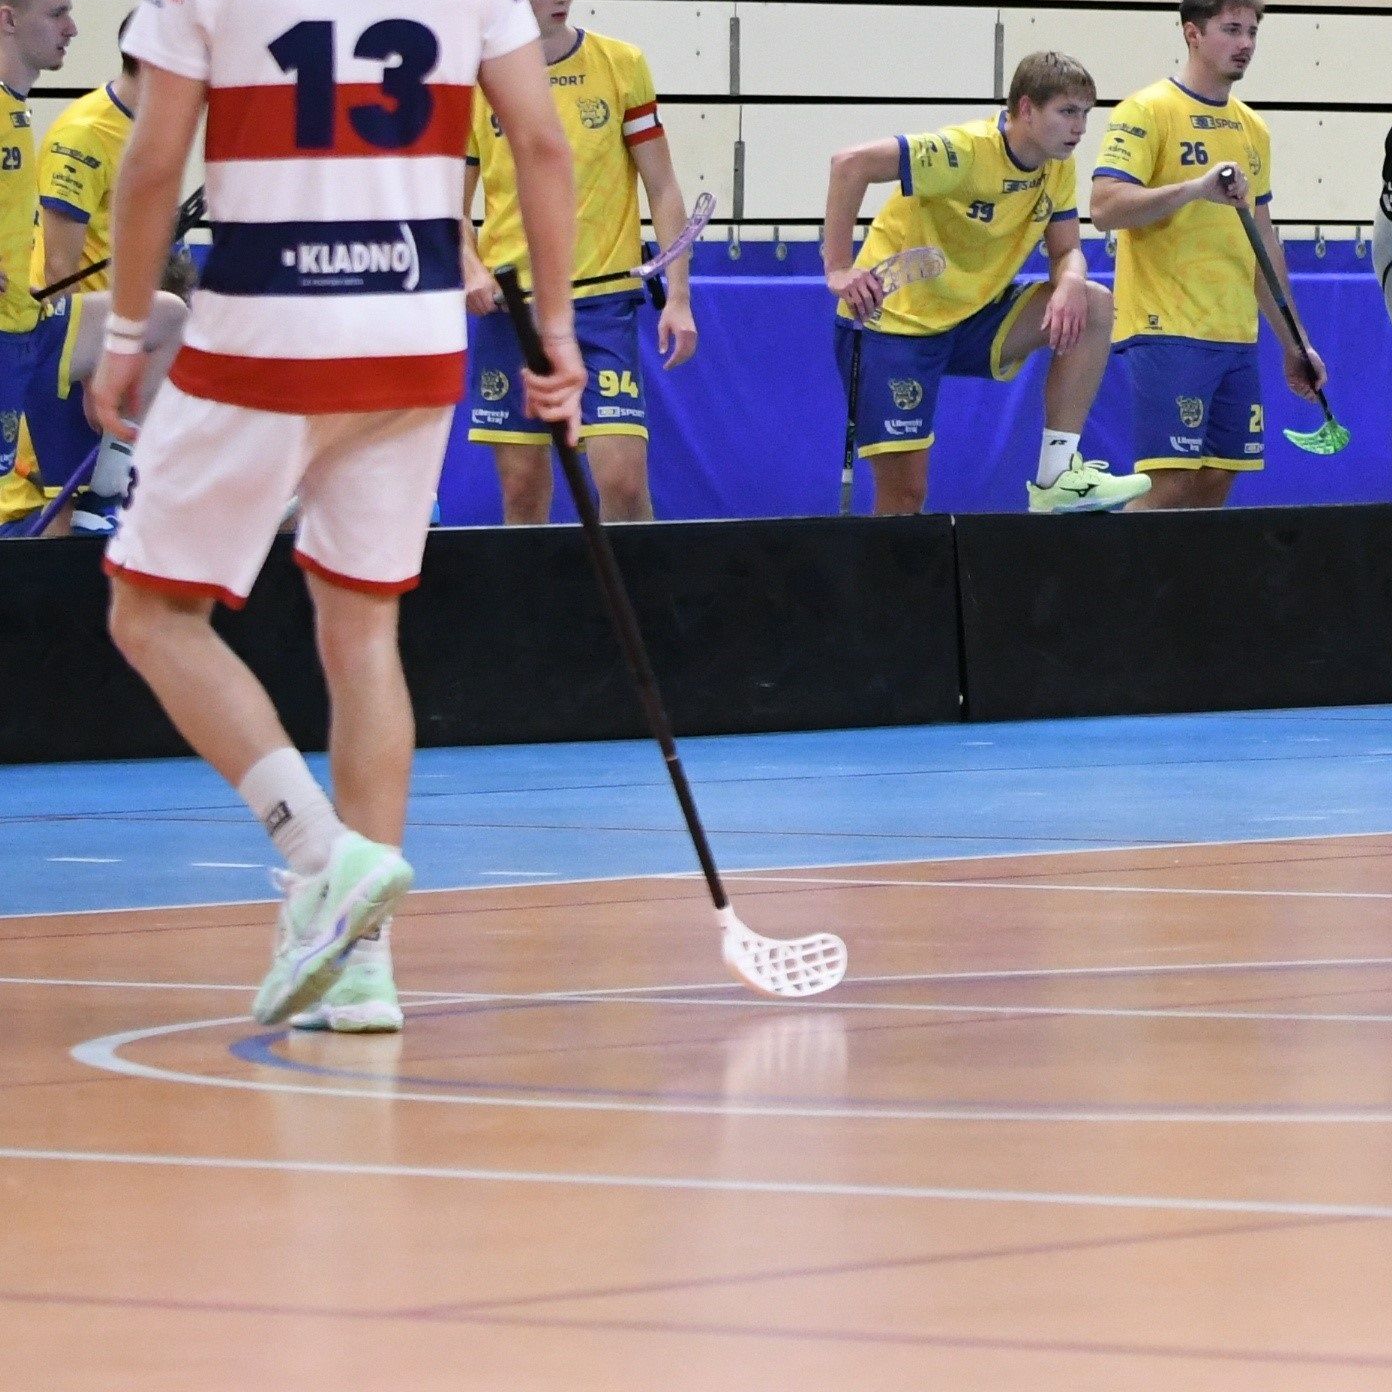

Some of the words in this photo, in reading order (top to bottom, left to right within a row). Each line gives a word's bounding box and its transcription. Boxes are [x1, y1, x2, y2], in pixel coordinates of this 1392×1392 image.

[266, 17, 440, 151] 13
[1, 145, 22, 171] 29
[1180, 140, 1209, 166] 26
[965, 199, 996, 223] 59
[300, 241, 410, 275] KLADNO
[598, 369, 639, 399] 94
[1248, 403, 1265, 434] 2
